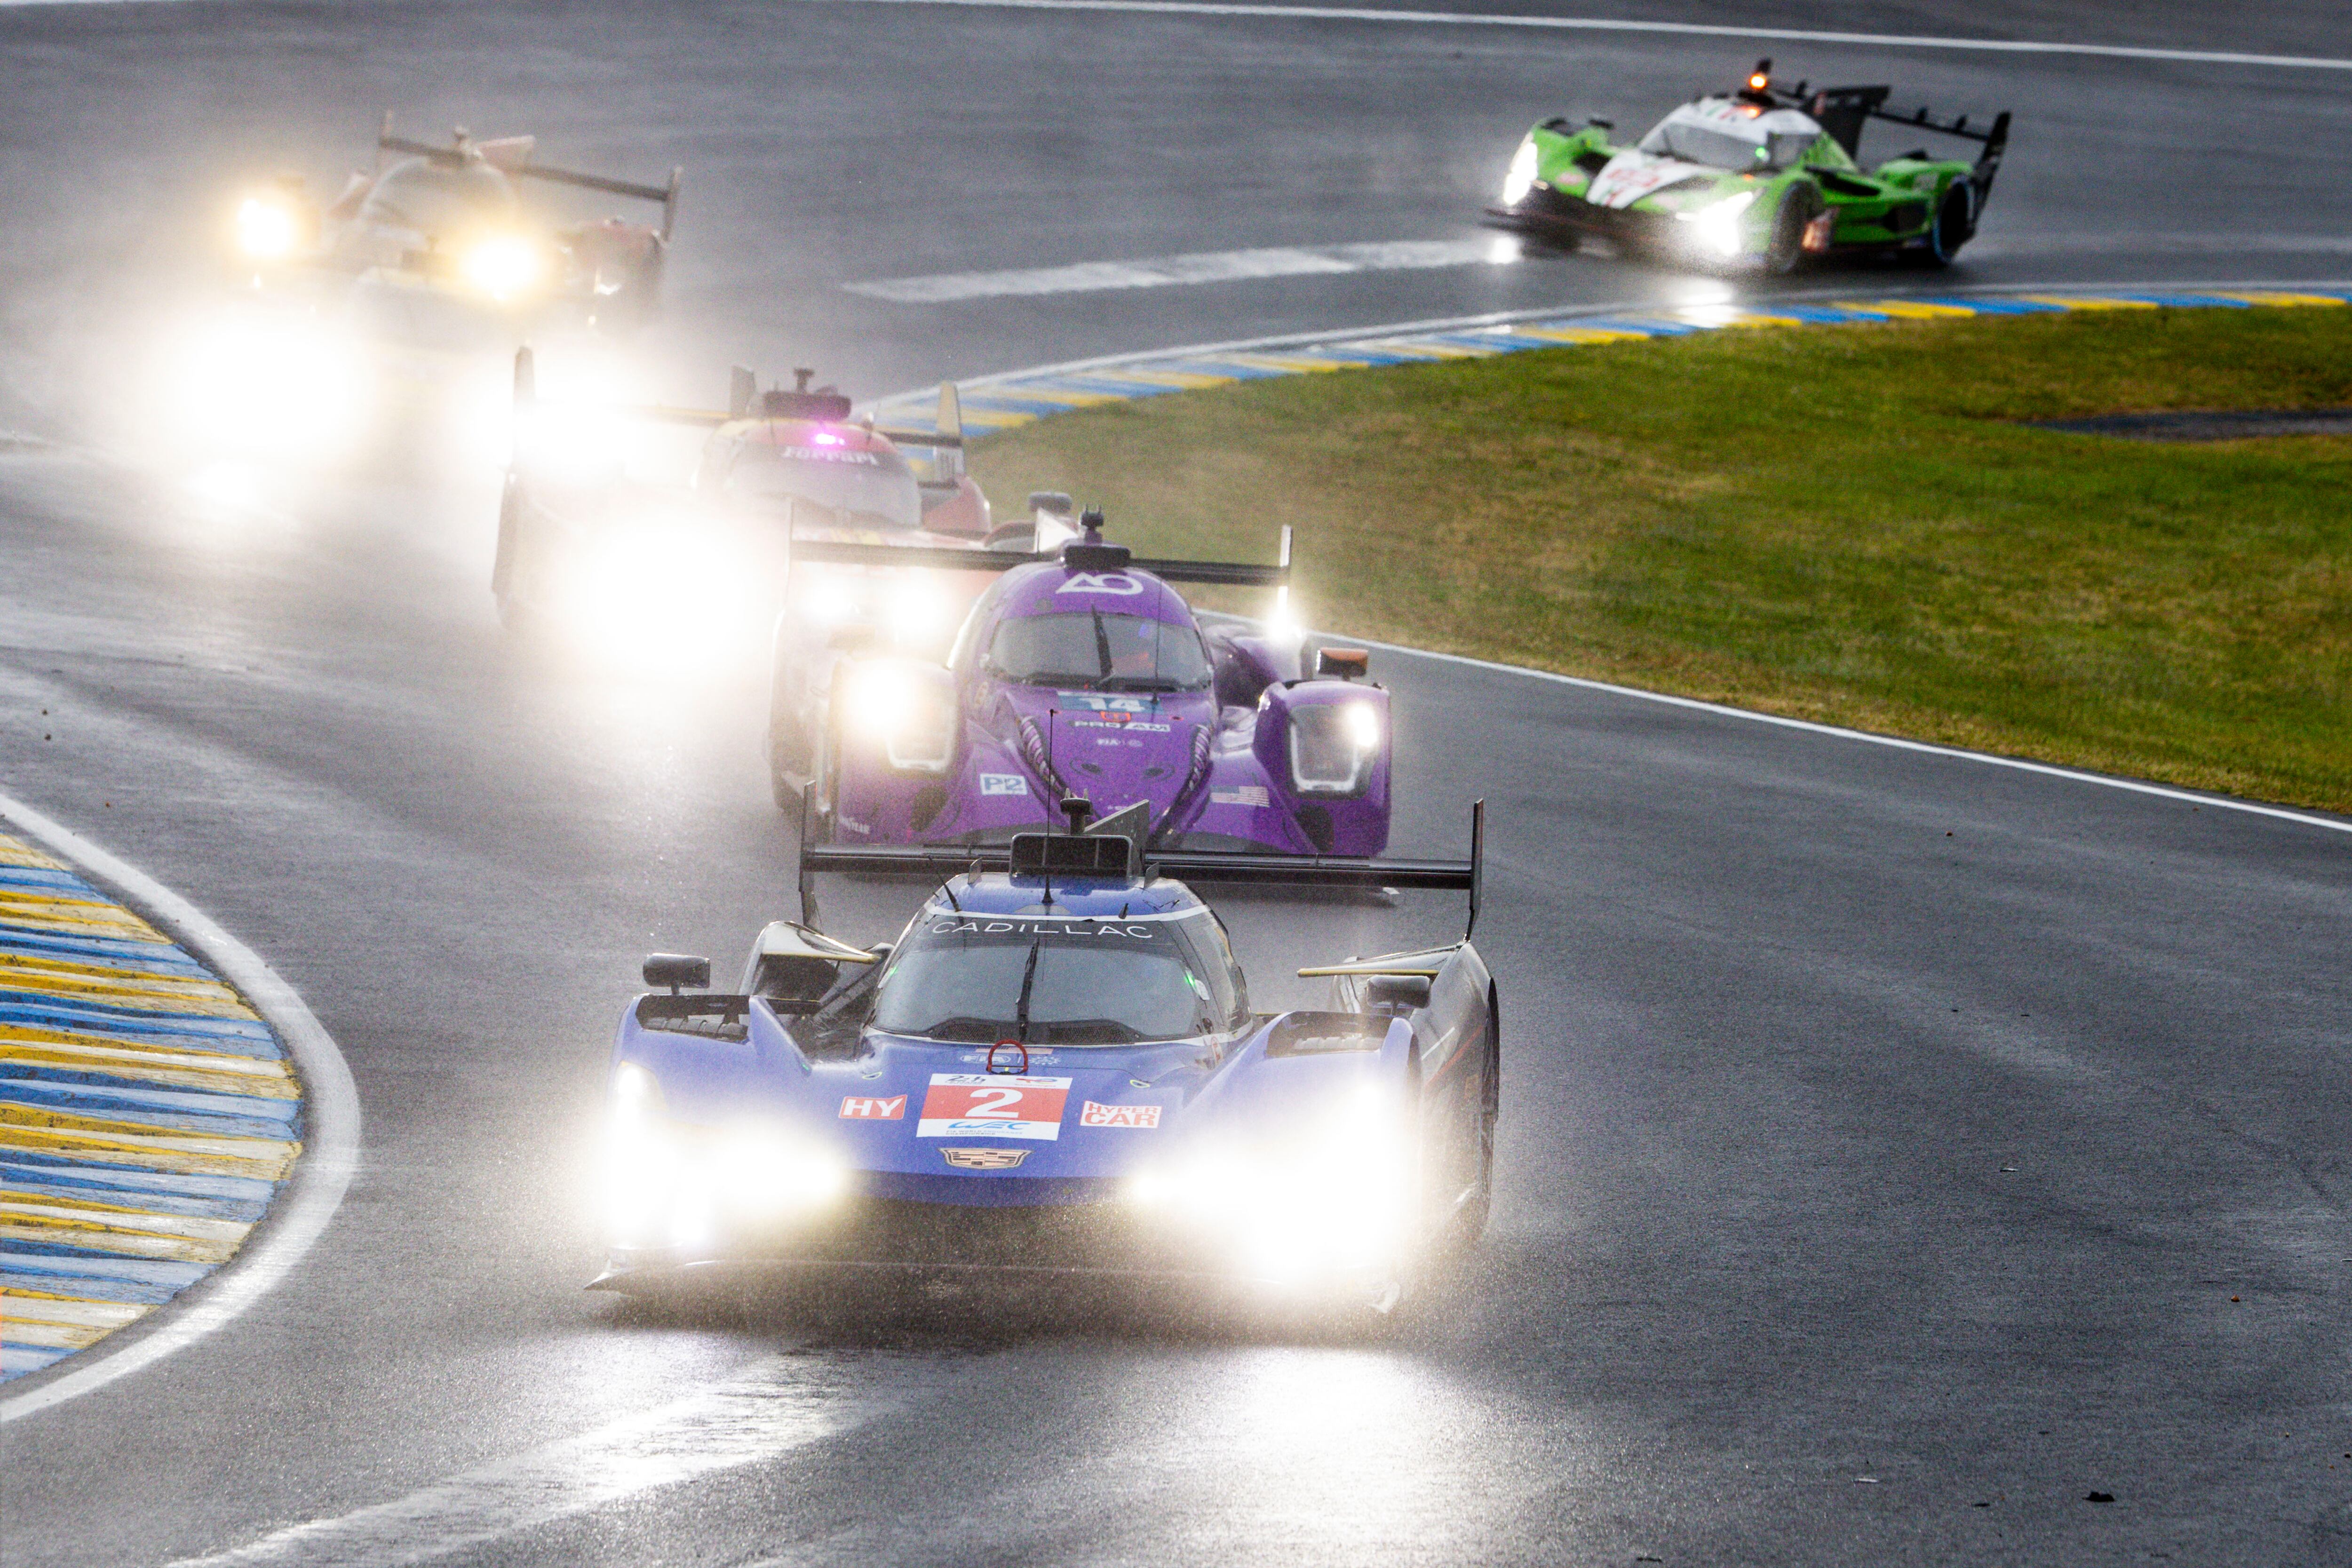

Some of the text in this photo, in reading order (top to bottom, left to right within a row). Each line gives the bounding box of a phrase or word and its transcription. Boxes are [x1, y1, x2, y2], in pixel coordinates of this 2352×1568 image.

[1080, 698, 1146, 712] 14
[985, 777, 1023, 790] P2
[932, 923, 1152, 938] CADILLAC
[843, 1098, 903, 1116] HY
[965, 1088, 1023, 1118] 2
[1089, 1103, 1158, 1114] HYPER
[948, 1121, 1031, 1129] WEC
[1085, 1113, 1155, 1125] CAR
